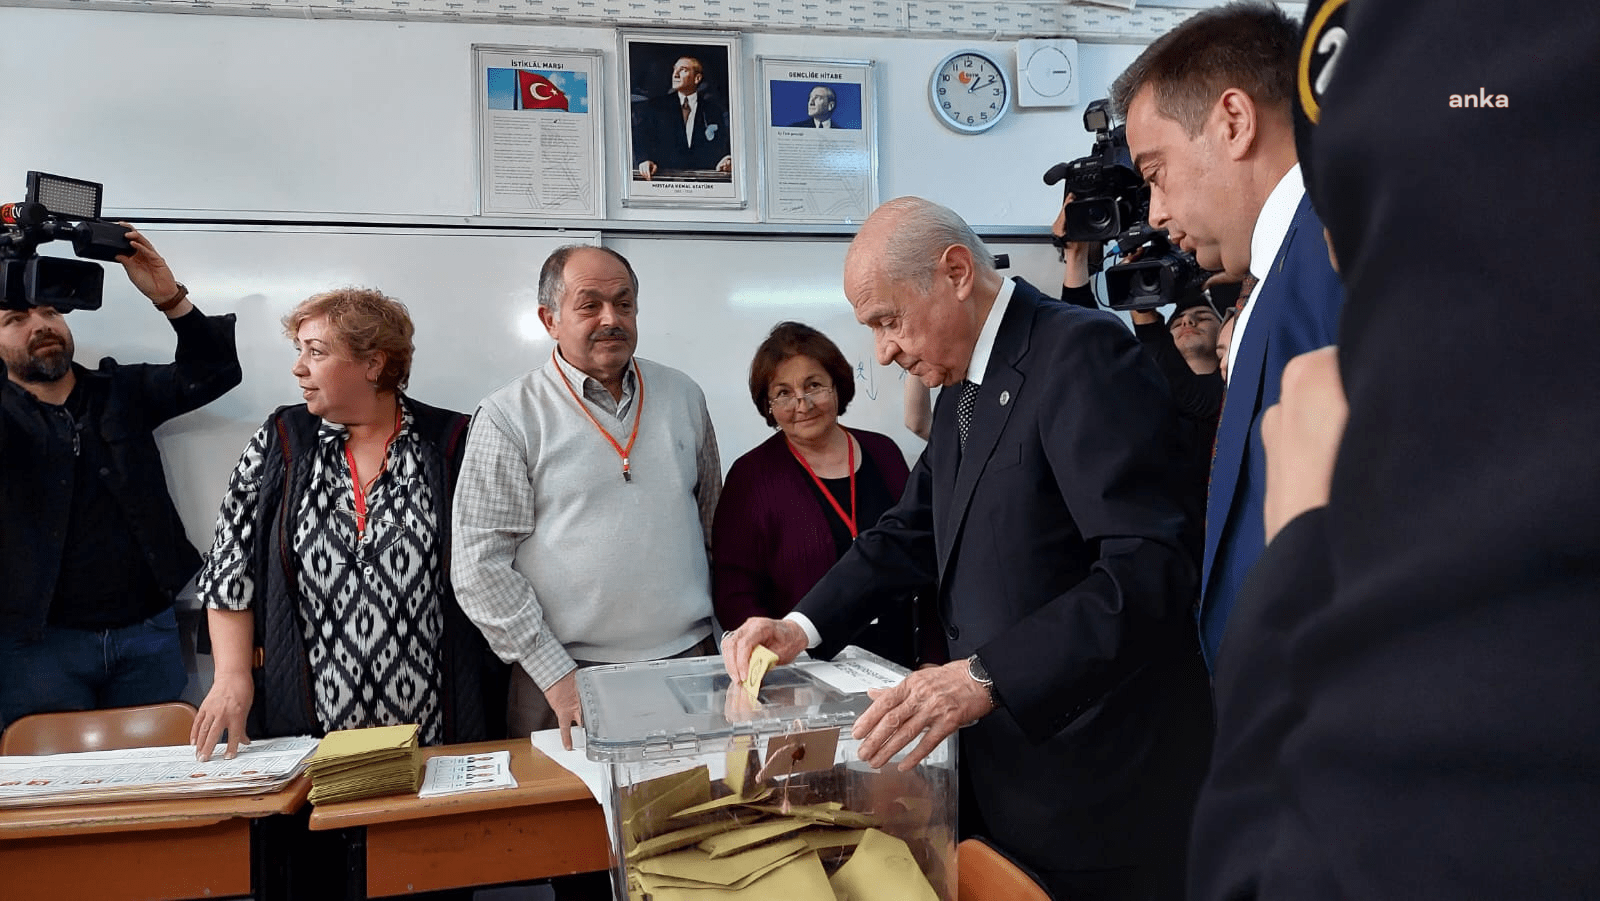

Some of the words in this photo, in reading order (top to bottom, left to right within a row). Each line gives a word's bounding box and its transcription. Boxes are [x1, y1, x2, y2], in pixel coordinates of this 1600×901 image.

[952, 63, 959, 71] 11
[963, 60, 973, 68] 12
[980, 64, 984, 72] 1
[942, 74, 951, 82] 10
[988, 74, 996, 84] 2
[939, 87, 946, 95] 9
[992, 88, 1000, 96] 3
[943, 101, 952, 109] 8
[954, 111, 961, 120] 7
[966, 115, 975, 124] 6
[980, 111, 988, 120] 5
